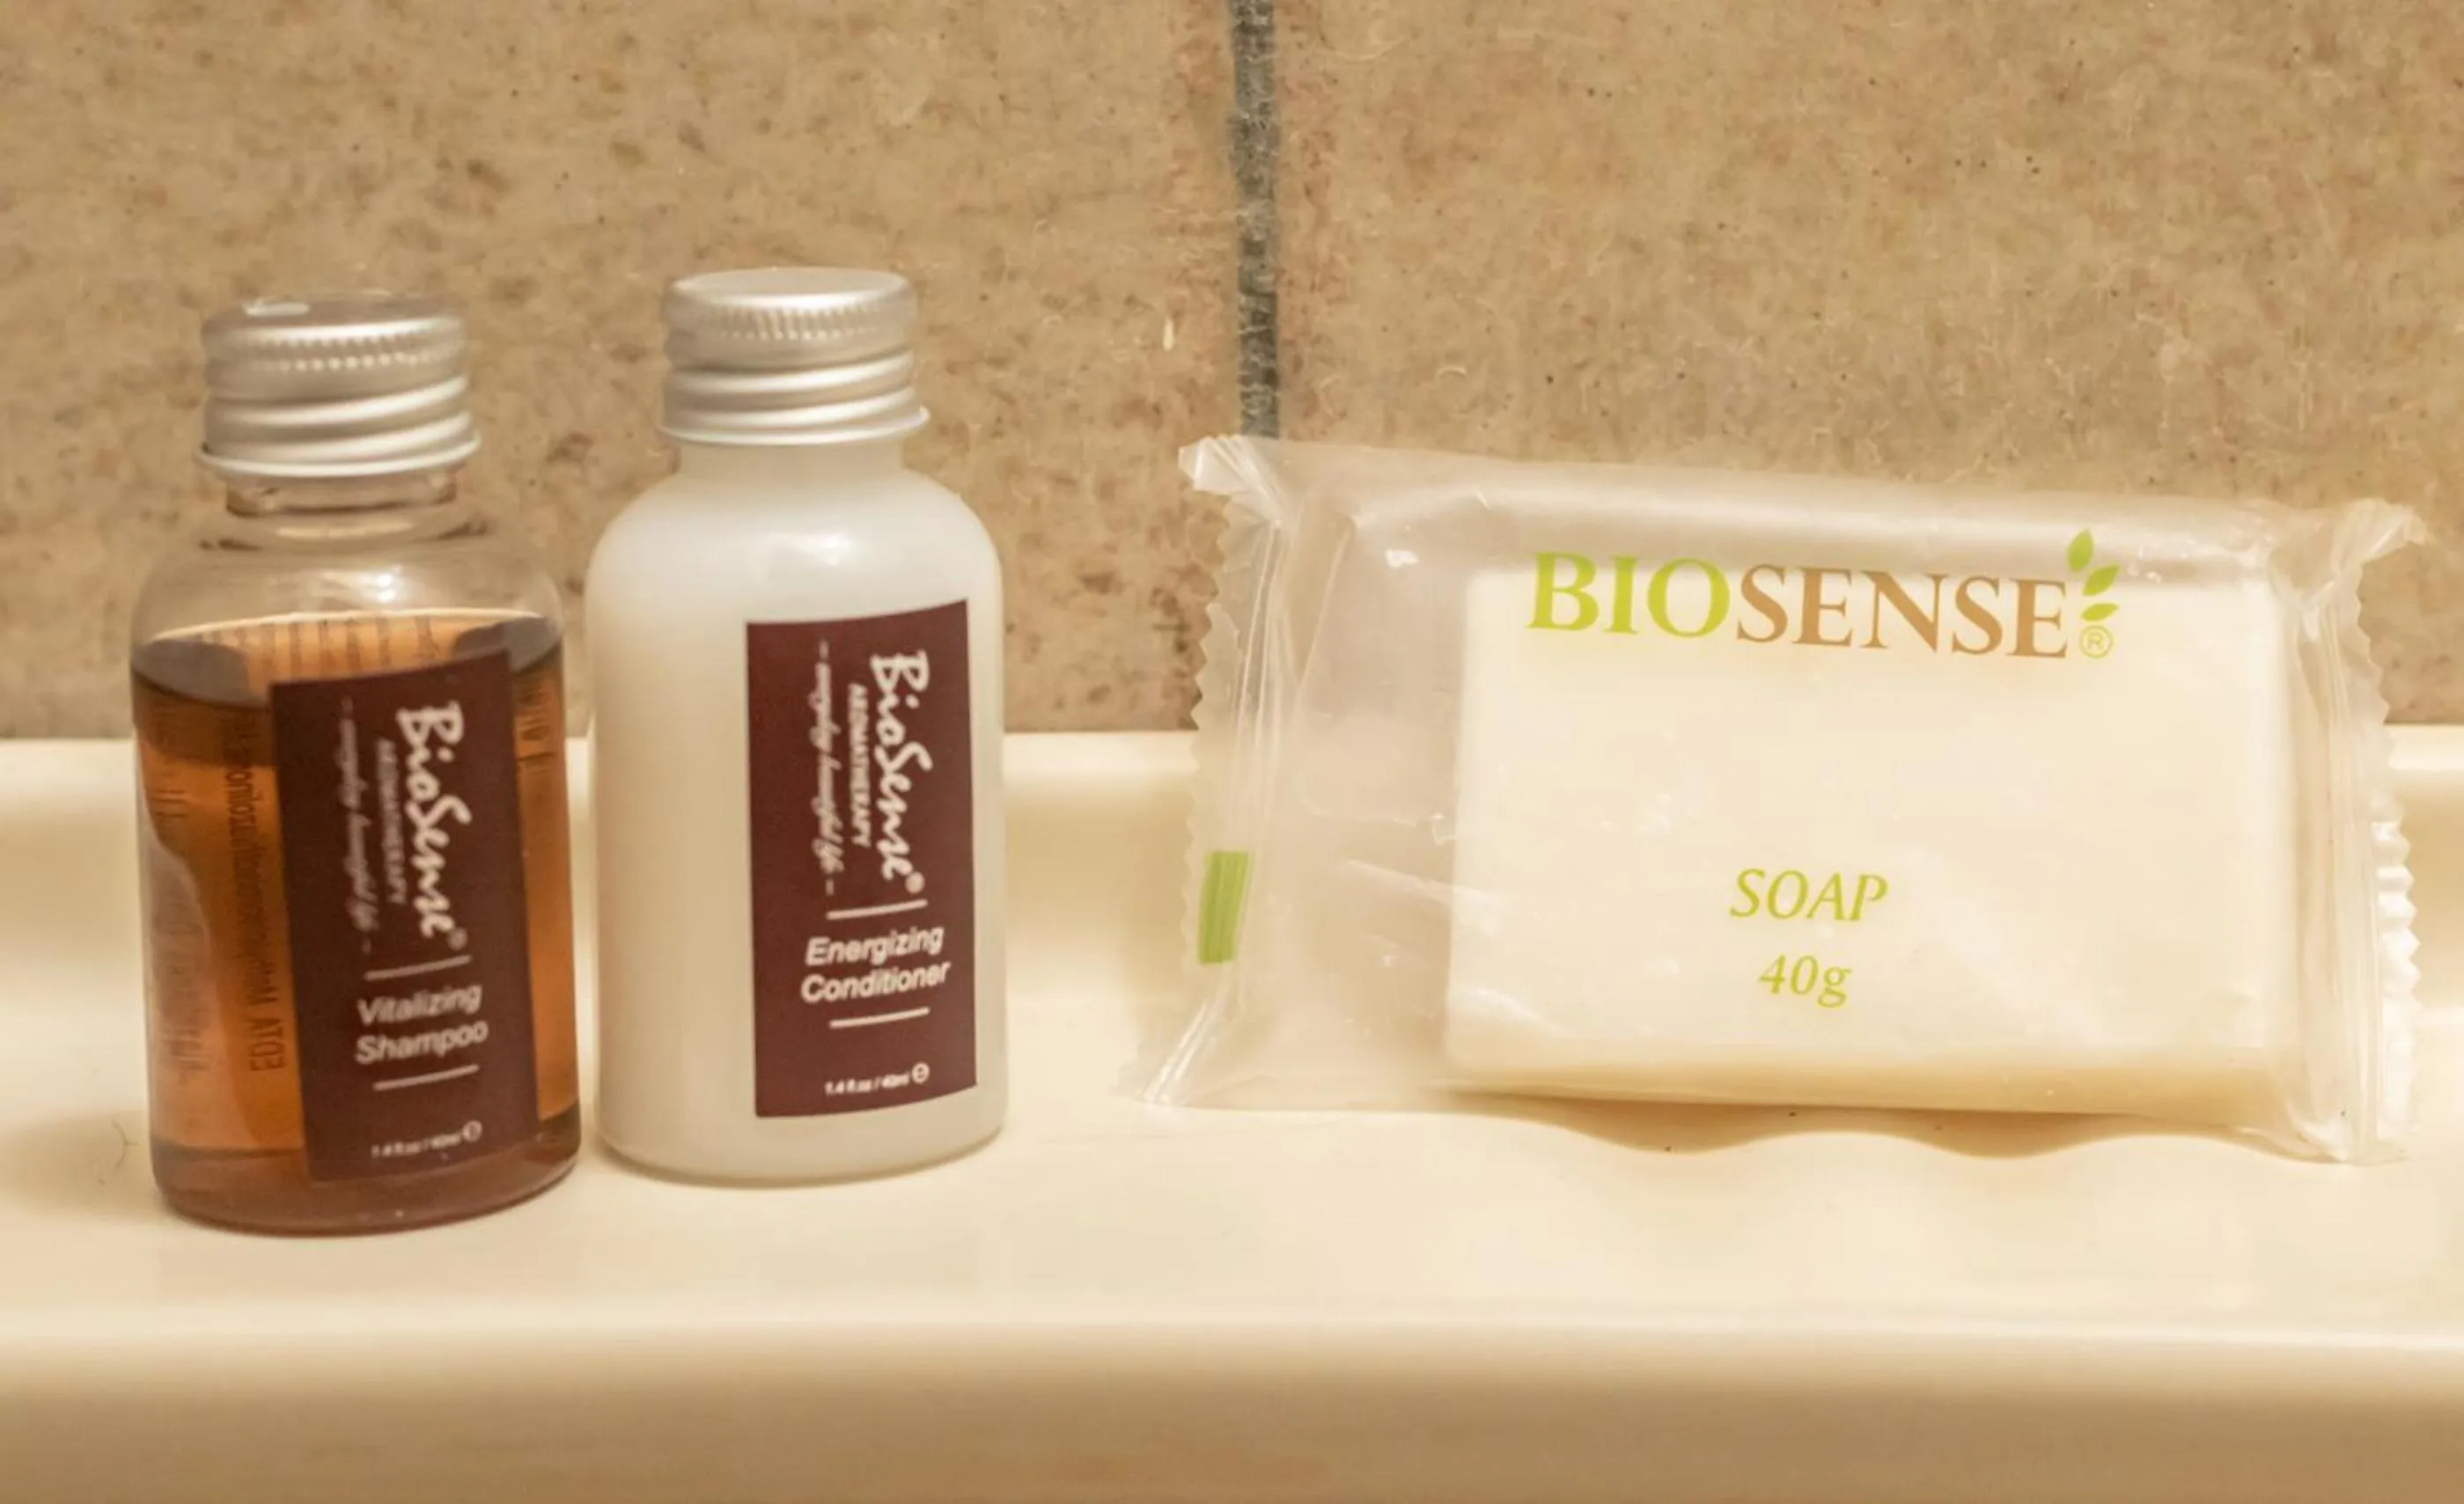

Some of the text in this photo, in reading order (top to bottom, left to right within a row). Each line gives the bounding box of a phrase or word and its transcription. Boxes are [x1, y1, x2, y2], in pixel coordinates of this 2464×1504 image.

[1526, 550, 2068, 659] BIOSENSE
[1729, 868, 1888, 922] SOAP
[805, 925, 945, 966] Energizing
[800, 958, 951, 1003] Conditioner
[1758, 954, 1852, 1009] 40g
[357, 983, 483, 1026] Vitalizing
[356, 1021, 489, 1067] Shampoo
